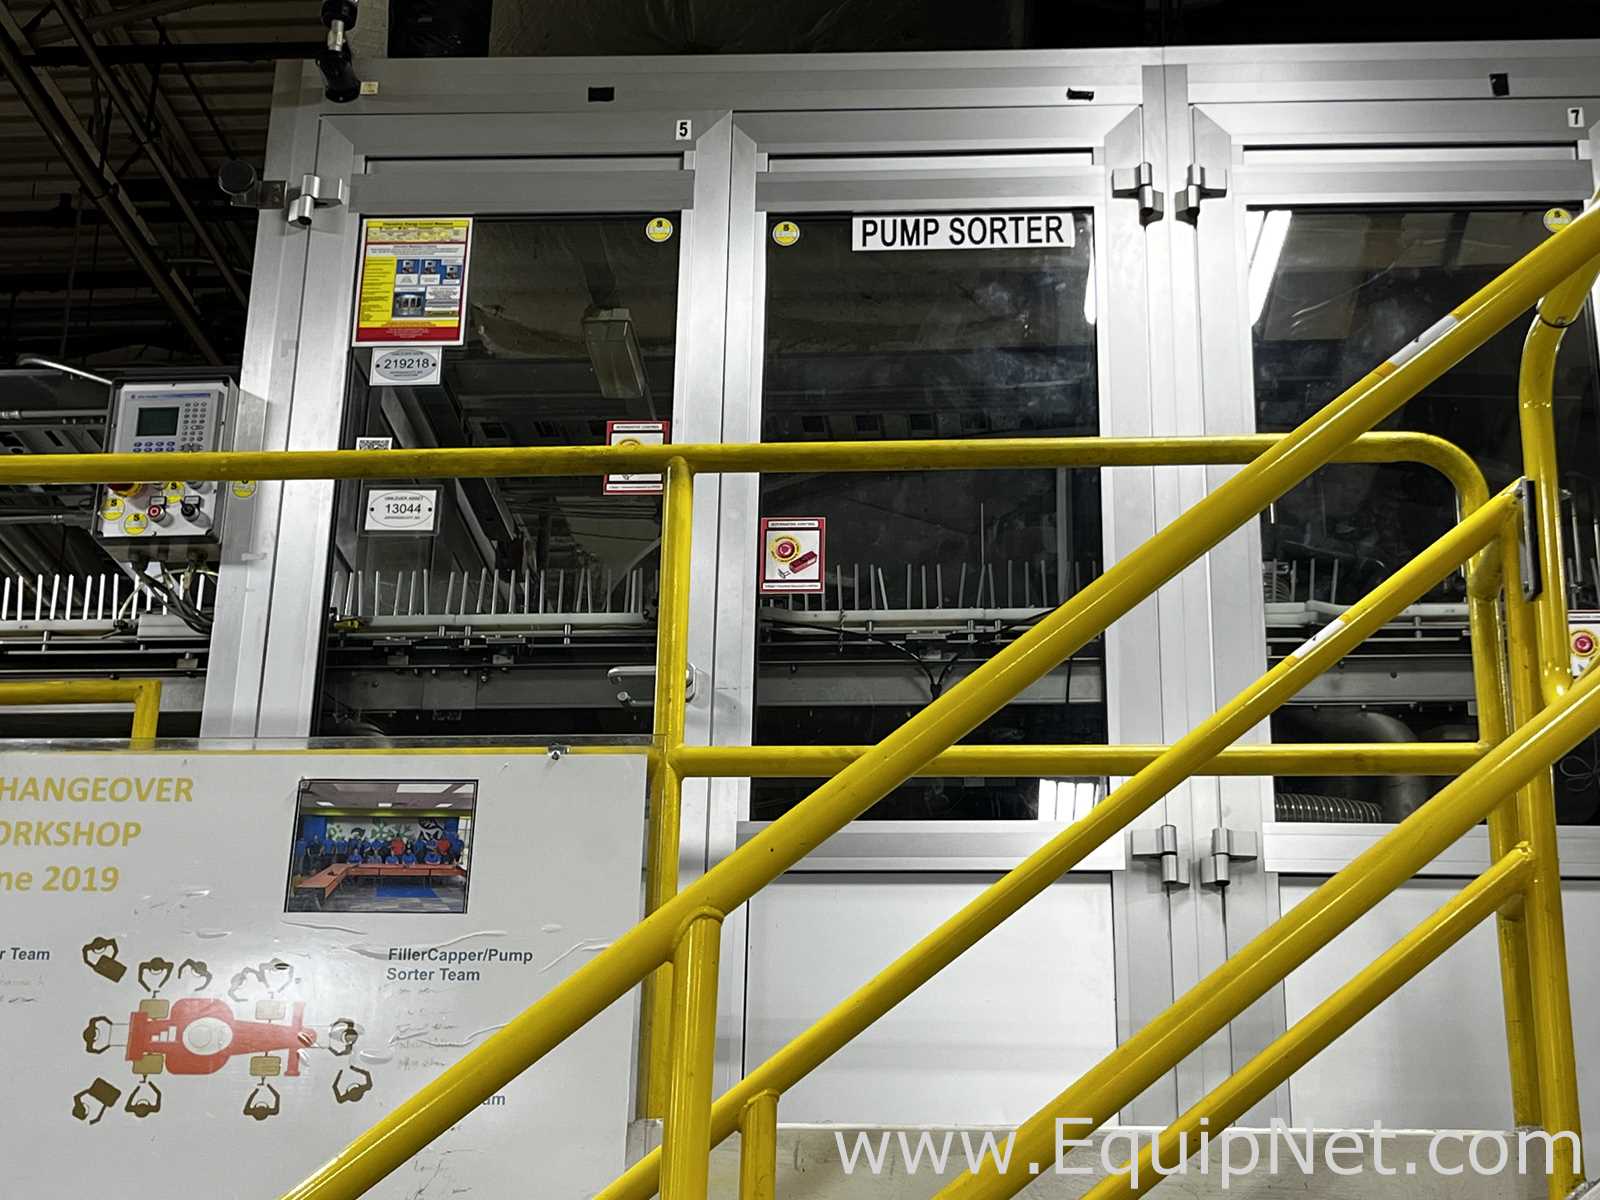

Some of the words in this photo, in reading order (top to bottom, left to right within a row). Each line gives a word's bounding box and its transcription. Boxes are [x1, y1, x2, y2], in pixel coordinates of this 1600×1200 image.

[1570, 109, 1579, 125] 7
[679, 121, 688, 137] 5
[862, 218, 939, 247] PUMP
[949, 216, 1064, 245] SORTER
[384, 358, 430, 370] 219218
[385, 503, 422, 514] 13044
[42, 865, 120, 892] 2019
[11, 947, 51, 961] Team
[388, 947, 533, 965] FillerCapper/Pump
[386, 967, 435, 982] Sorter
[440, 967, 480, 982] Team
